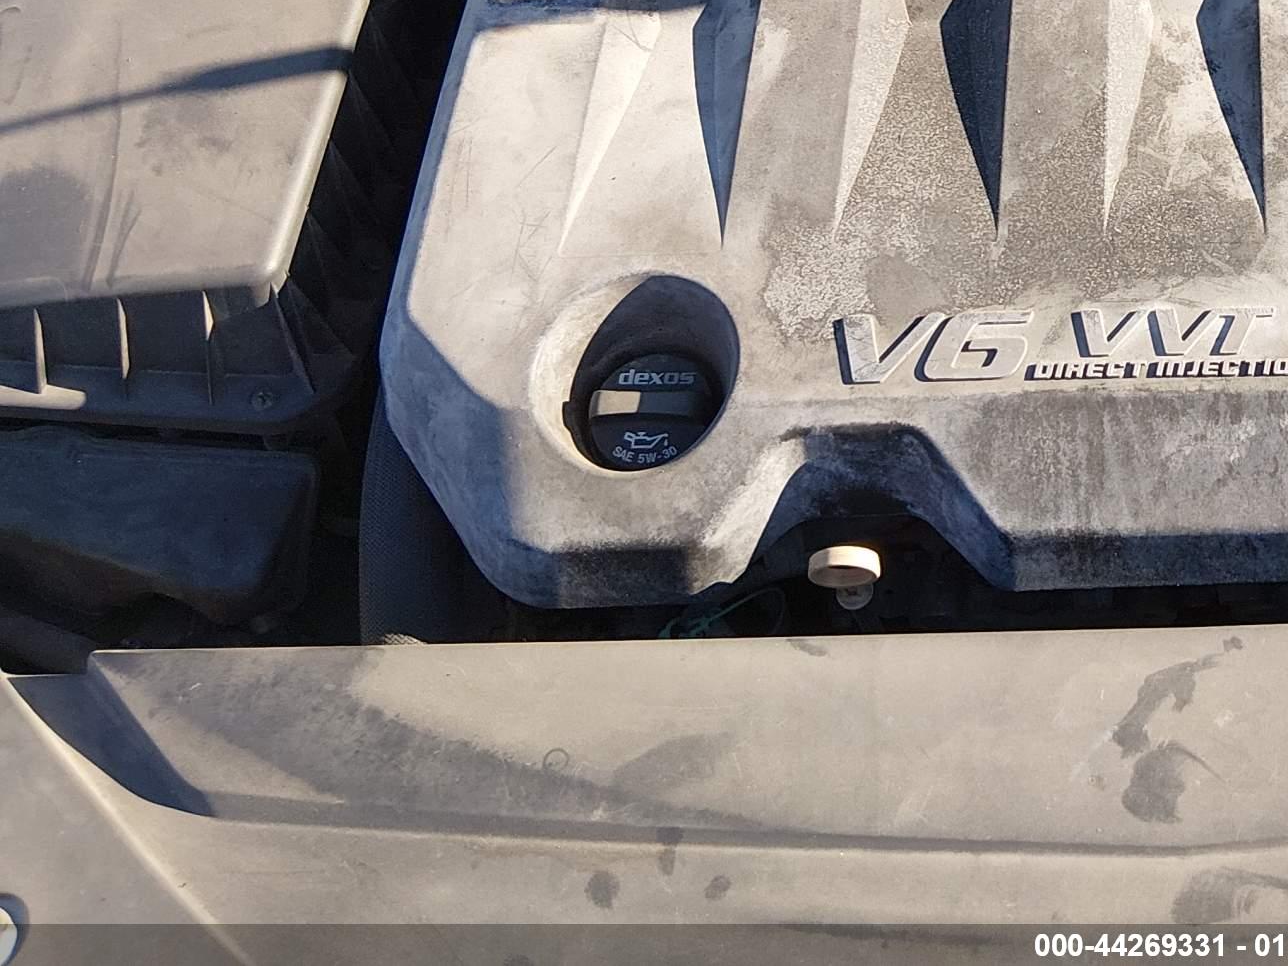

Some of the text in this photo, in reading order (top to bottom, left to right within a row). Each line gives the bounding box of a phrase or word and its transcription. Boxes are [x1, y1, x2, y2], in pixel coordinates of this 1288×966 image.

[833, 307, 1278, 385] V6 VVT
[618, 368, 697, 385] dexos
[1024, 360, 1146, 381] DIRECT
[612, 446, 678, 464] SAE 5W-30
